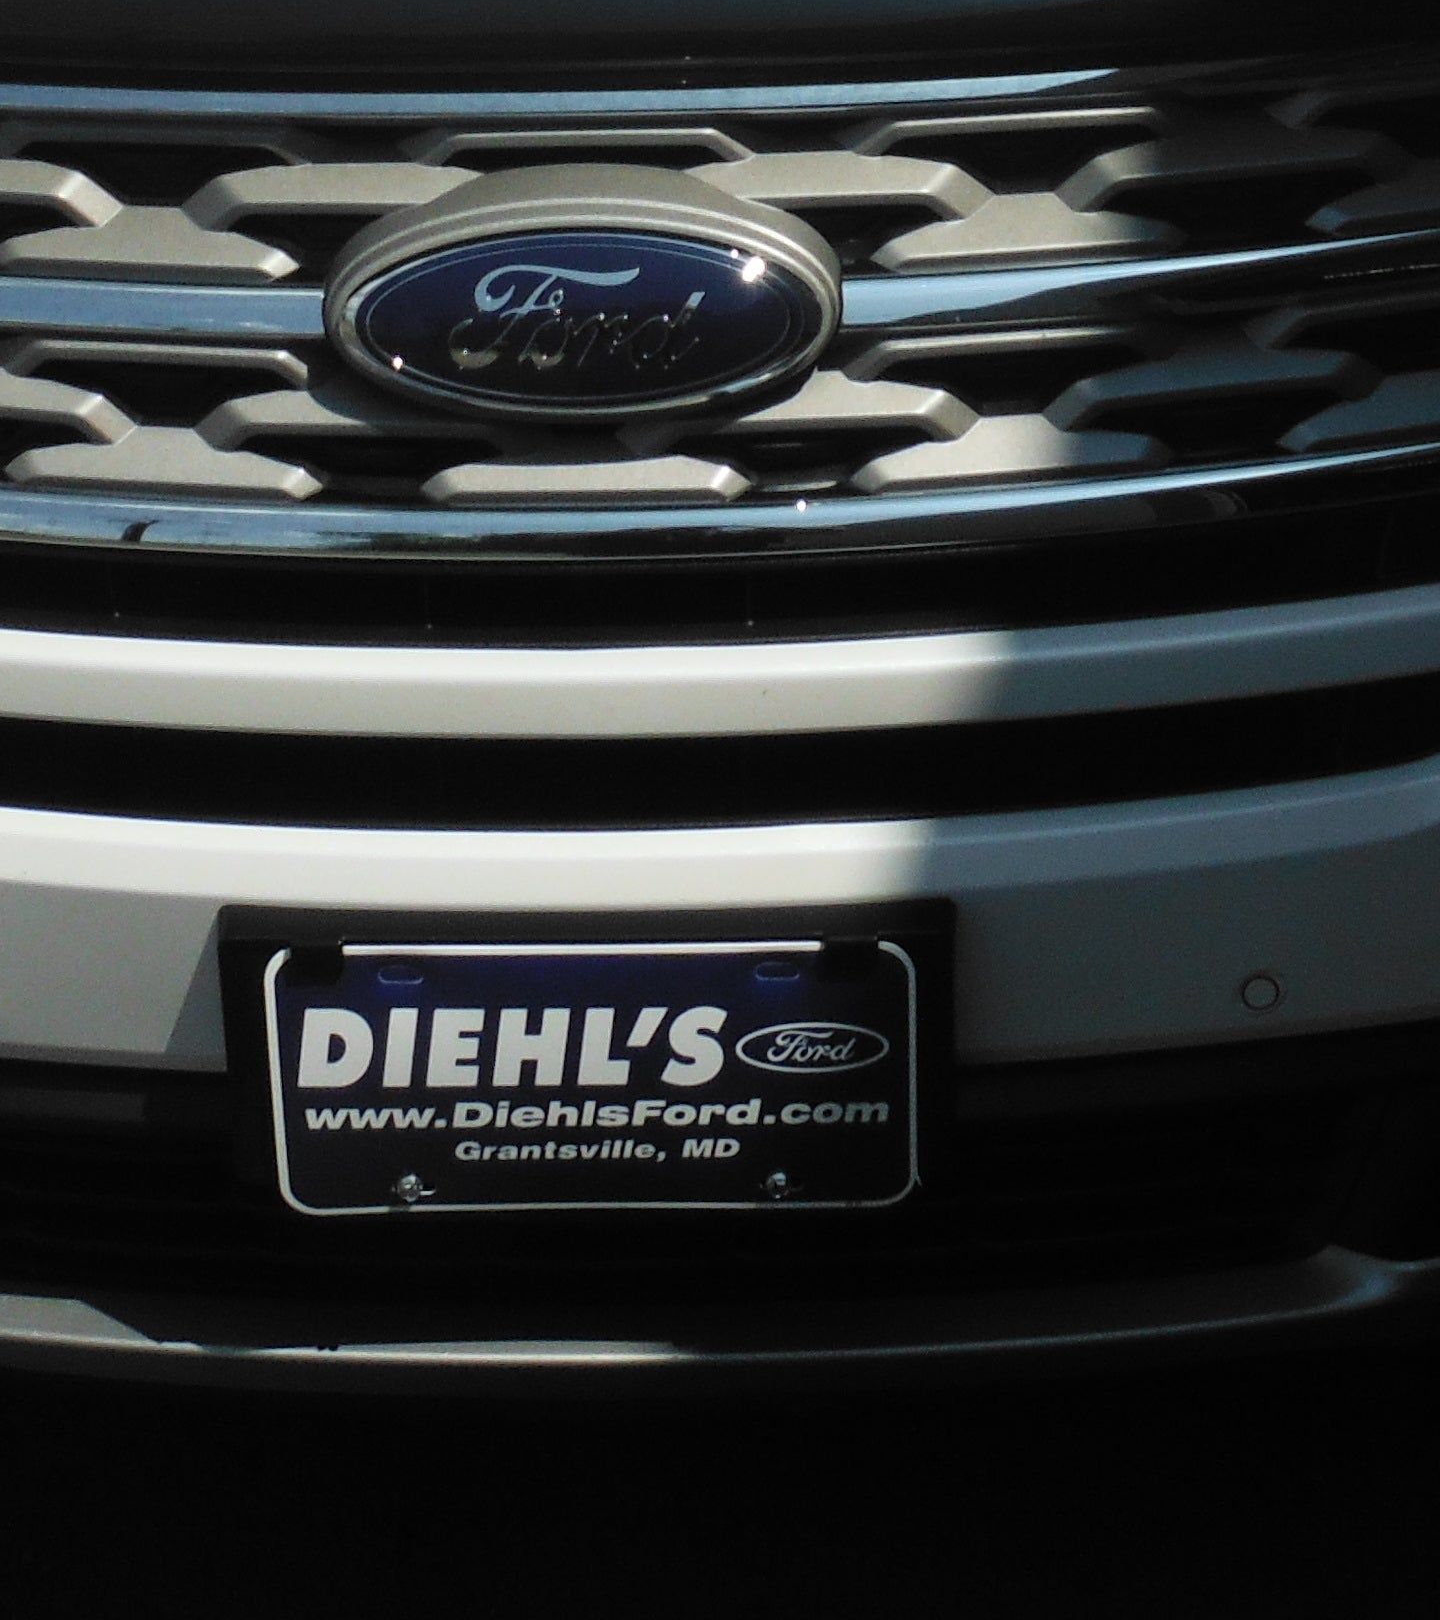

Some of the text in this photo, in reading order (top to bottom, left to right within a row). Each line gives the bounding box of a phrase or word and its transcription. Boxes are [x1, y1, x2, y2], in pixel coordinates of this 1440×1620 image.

[449, 264, 706, 369] Ford
[297, 1006, 857, 1089] DIEHL'S Ford
[305, 1097, 890, 1130] www.DiehlsFord.com
[454, 1139, 742, 1164] Grantsville, MD
